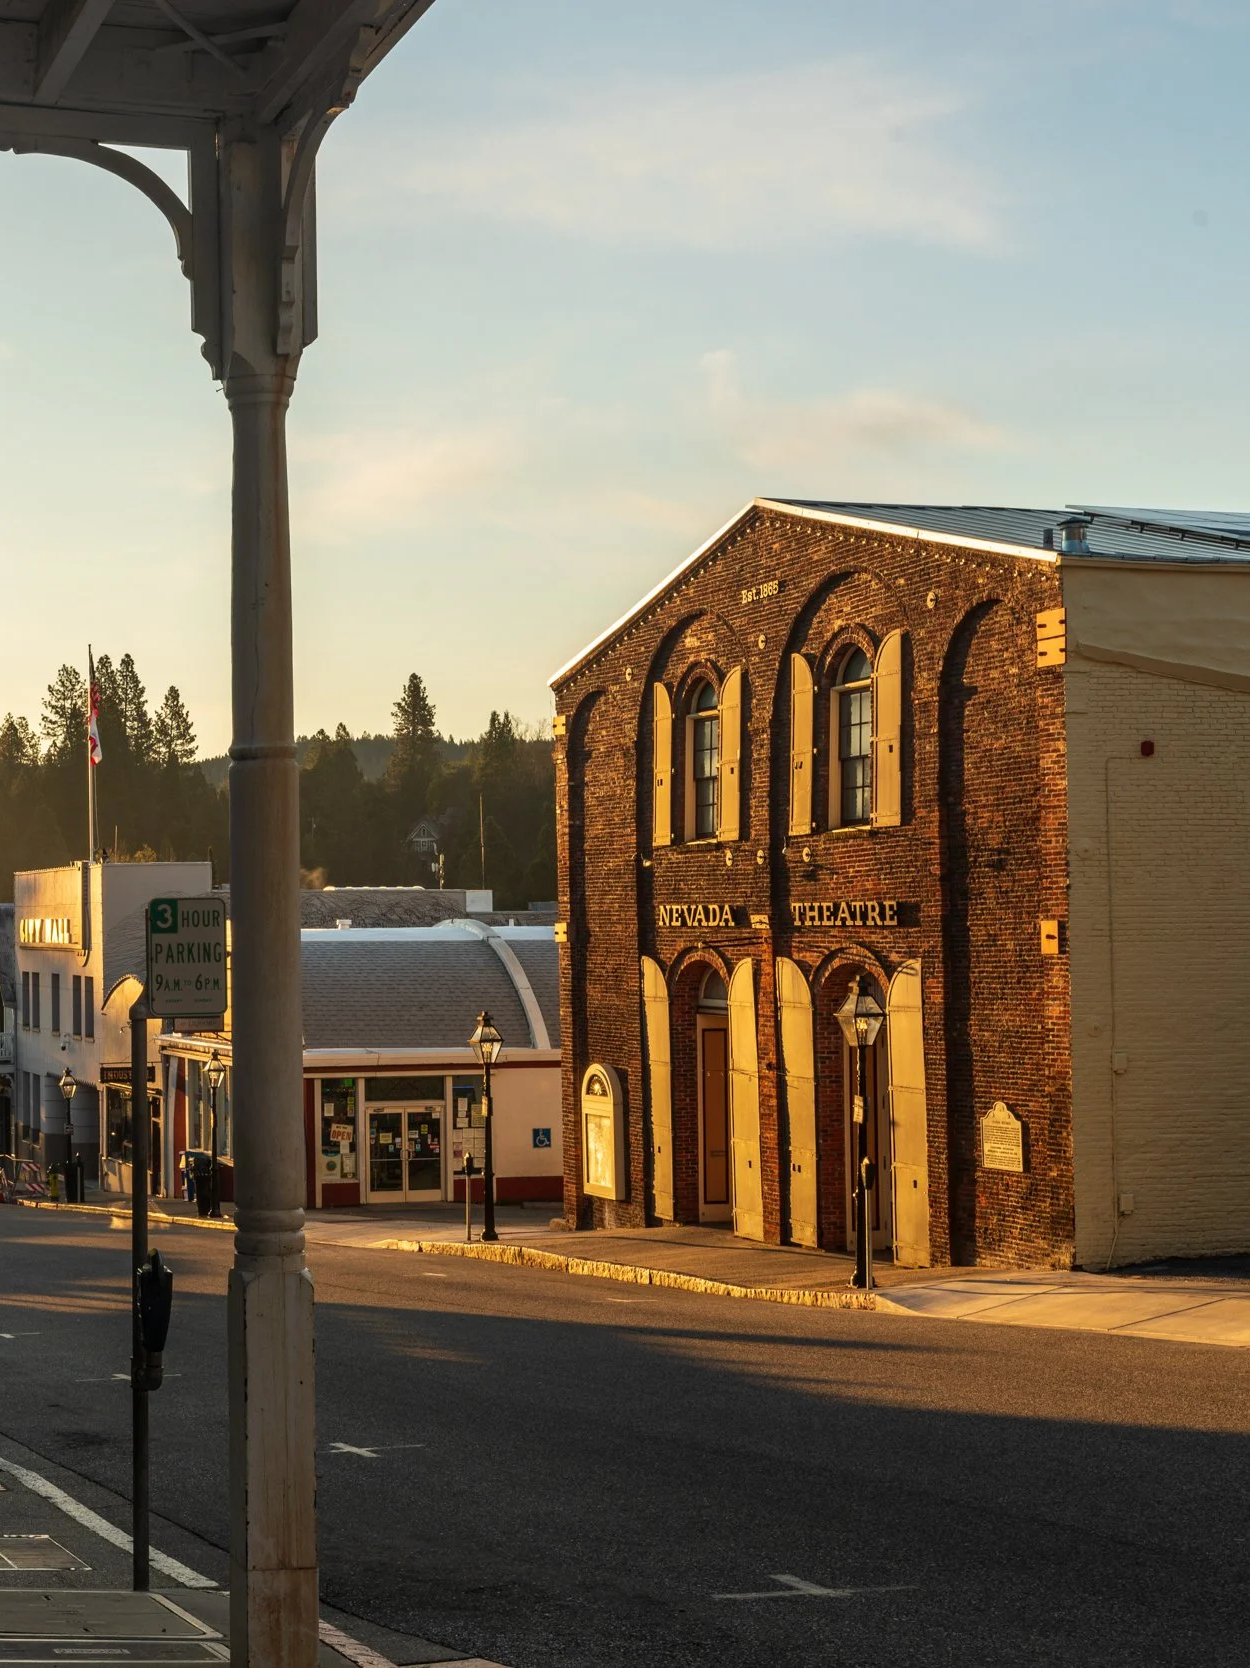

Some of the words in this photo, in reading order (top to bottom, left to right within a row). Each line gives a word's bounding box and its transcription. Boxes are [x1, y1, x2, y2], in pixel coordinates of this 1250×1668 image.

[157, 904, 173, 929] 3
[181, 910, 221, 928] HOUR
[658, 904, 735, 927] NEVADA
[791, 901, 898, 926] THEATRE
[19, 918, 43, 943] CITY
[45, 918, 73, 943] HALL
[155, 942, 222, 964] PARKING
[331, 1130, 352, 1141] OPEN
